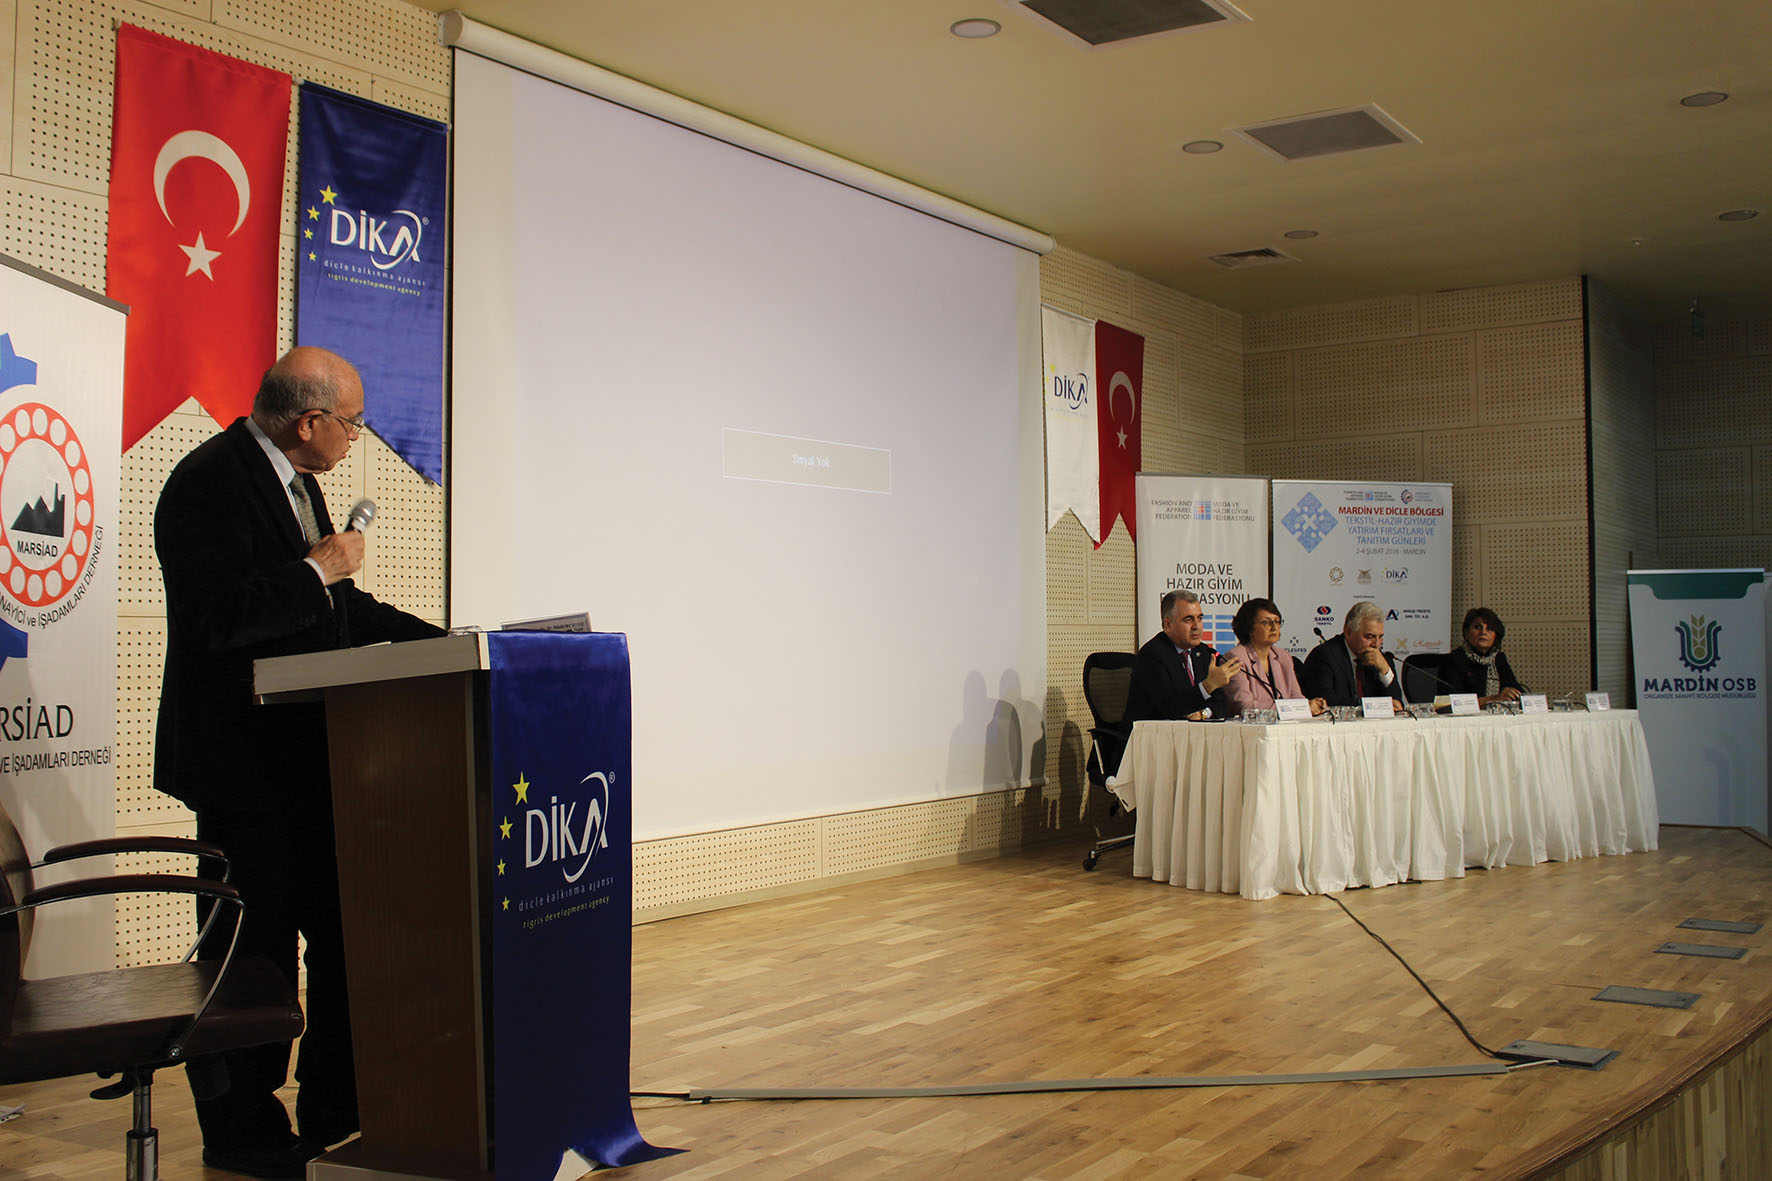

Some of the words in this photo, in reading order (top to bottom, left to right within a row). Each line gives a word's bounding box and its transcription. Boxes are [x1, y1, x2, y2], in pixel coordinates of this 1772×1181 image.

[324, 260, 349, 271] dicle
[352, 264, 394, 280] kalkınma
[328, 273, 348, 282] tigris
[350, 277, 396, 291] development
[397, 287, 421, 296] agency
[1213, 514, 1255, 522] FEDERASYONU
[1338, 504, 1373, 515] MARDİN
[1374, 507, 1384, 515] VE
[1385, 506, 1408, 516] DİCLE
[1410, 506, 1444, 516] BÖLGESİ
[1347, 526, 1379, 535] YATIRIM
[1380, 527, 1424, 535] FIRSATLARI
[1425, 527, 1435, 536] VE
[17, 540, 58, 557] MARSİAD
[1357, 536, 1390, 545] TANITIM
[1391, 535, 1426, 545] GÜNLERİ
[1176, 563, 1216, 575] MODA
[1217, 564, 1233, 575] VE
[1166, 578, 1205, 590] HAZIR
[1207, 576, 1243, 590] GİYİM
[27, 616, 36, 627] ve
[1644, 675, 1719, 692] MARDİN
[1722, 678, 1757, 692] OSB
[0, 697, 73, 741] RSİAD
[12, 752, 70, 776] İŞADAMLARI
[72, 746, 111, 767] DERNEĞİ
[519, 897, 544, 912] dicle
[546, 885, 586, 903] kalkınma
[589, 876, 614, 892] ajansı
[523, 916, 544, 930] tigris
[545, 902, 588, 923] development
[589, 895, 609, 909] agency
